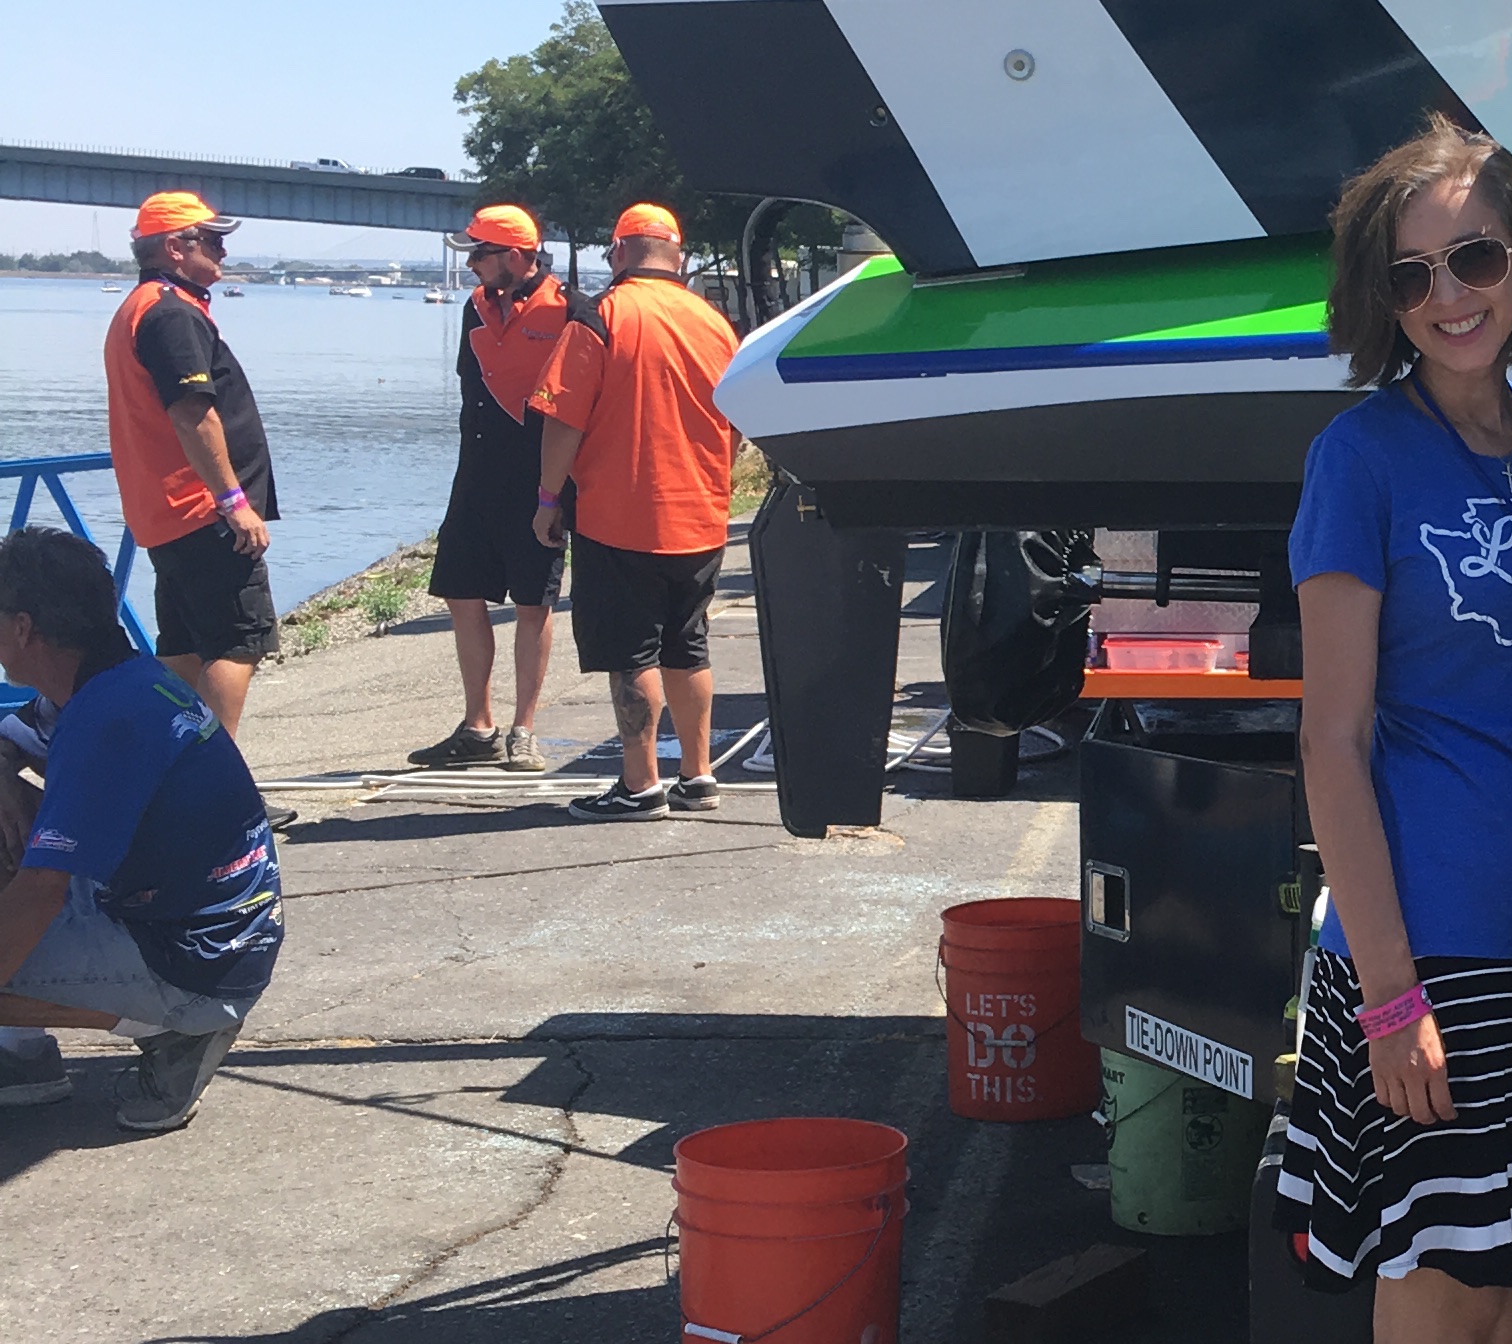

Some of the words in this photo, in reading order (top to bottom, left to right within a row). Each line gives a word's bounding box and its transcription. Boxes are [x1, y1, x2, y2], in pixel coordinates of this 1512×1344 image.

[965, 992, 1036, 1018] LET'S
[966, 1021, 1036, 1069] DO
[1128, 1010, 1200, 1080] TIE-DOWN
[1203, 1043, 1250, 1094] POINT
